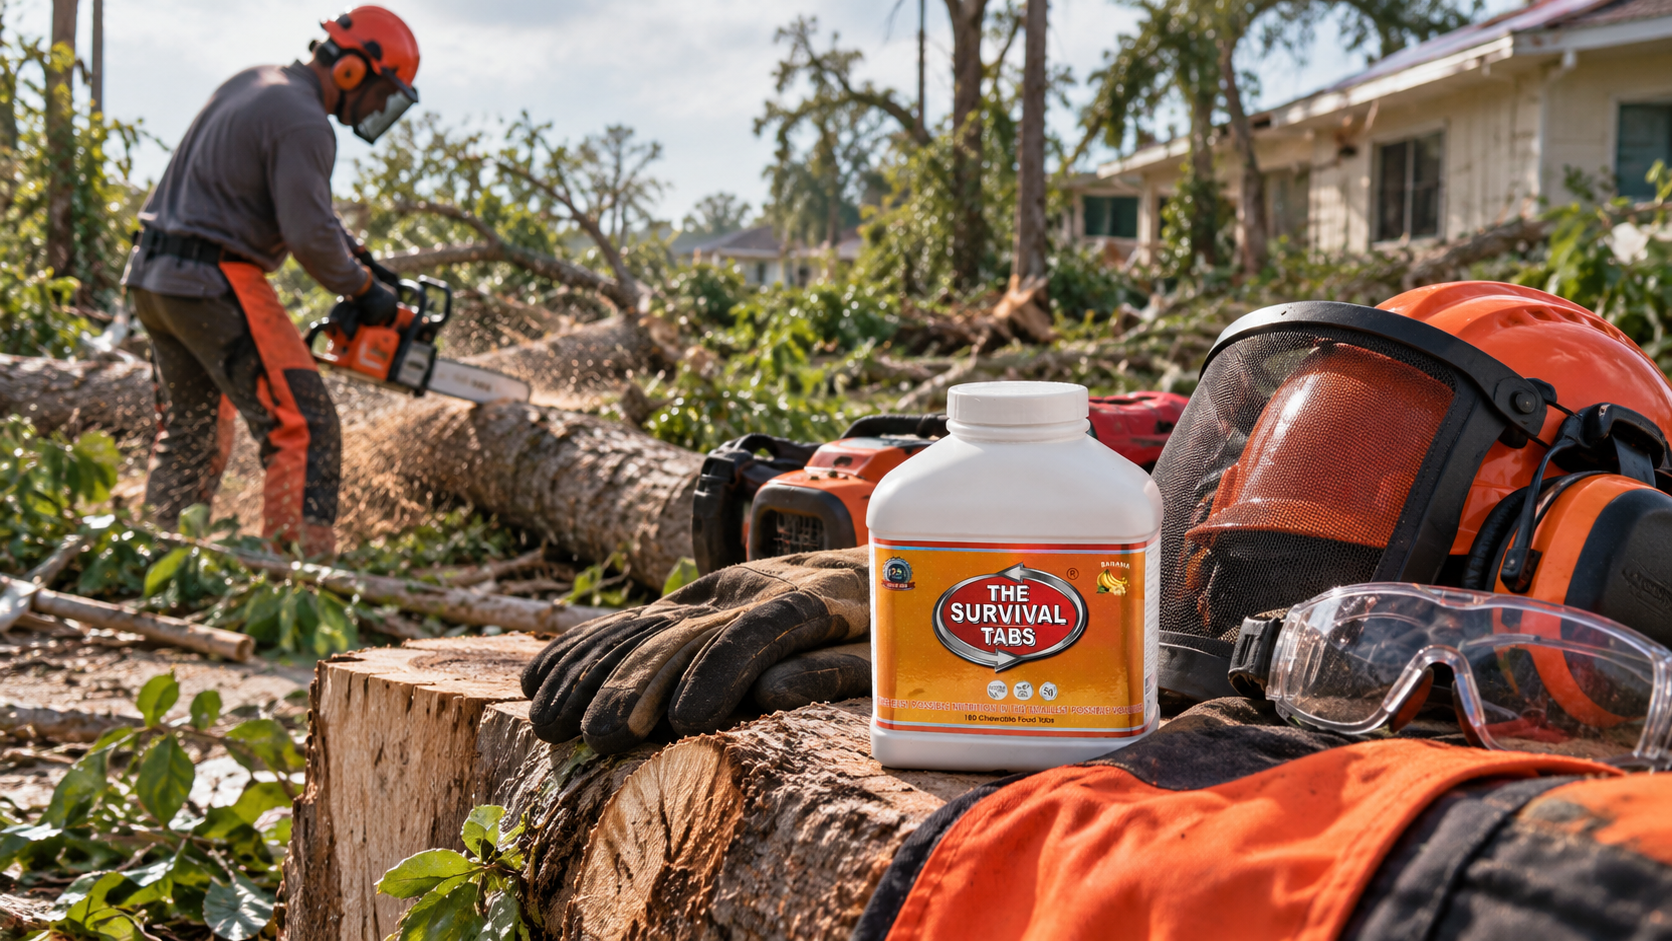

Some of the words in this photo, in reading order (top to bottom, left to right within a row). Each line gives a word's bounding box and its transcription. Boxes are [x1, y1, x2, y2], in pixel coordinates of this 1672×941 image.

[987, 584, 1029, 603] THE
[950, 603, 1068, 625] SURVIVAL
[981, 627, 1036, 646] TABS
